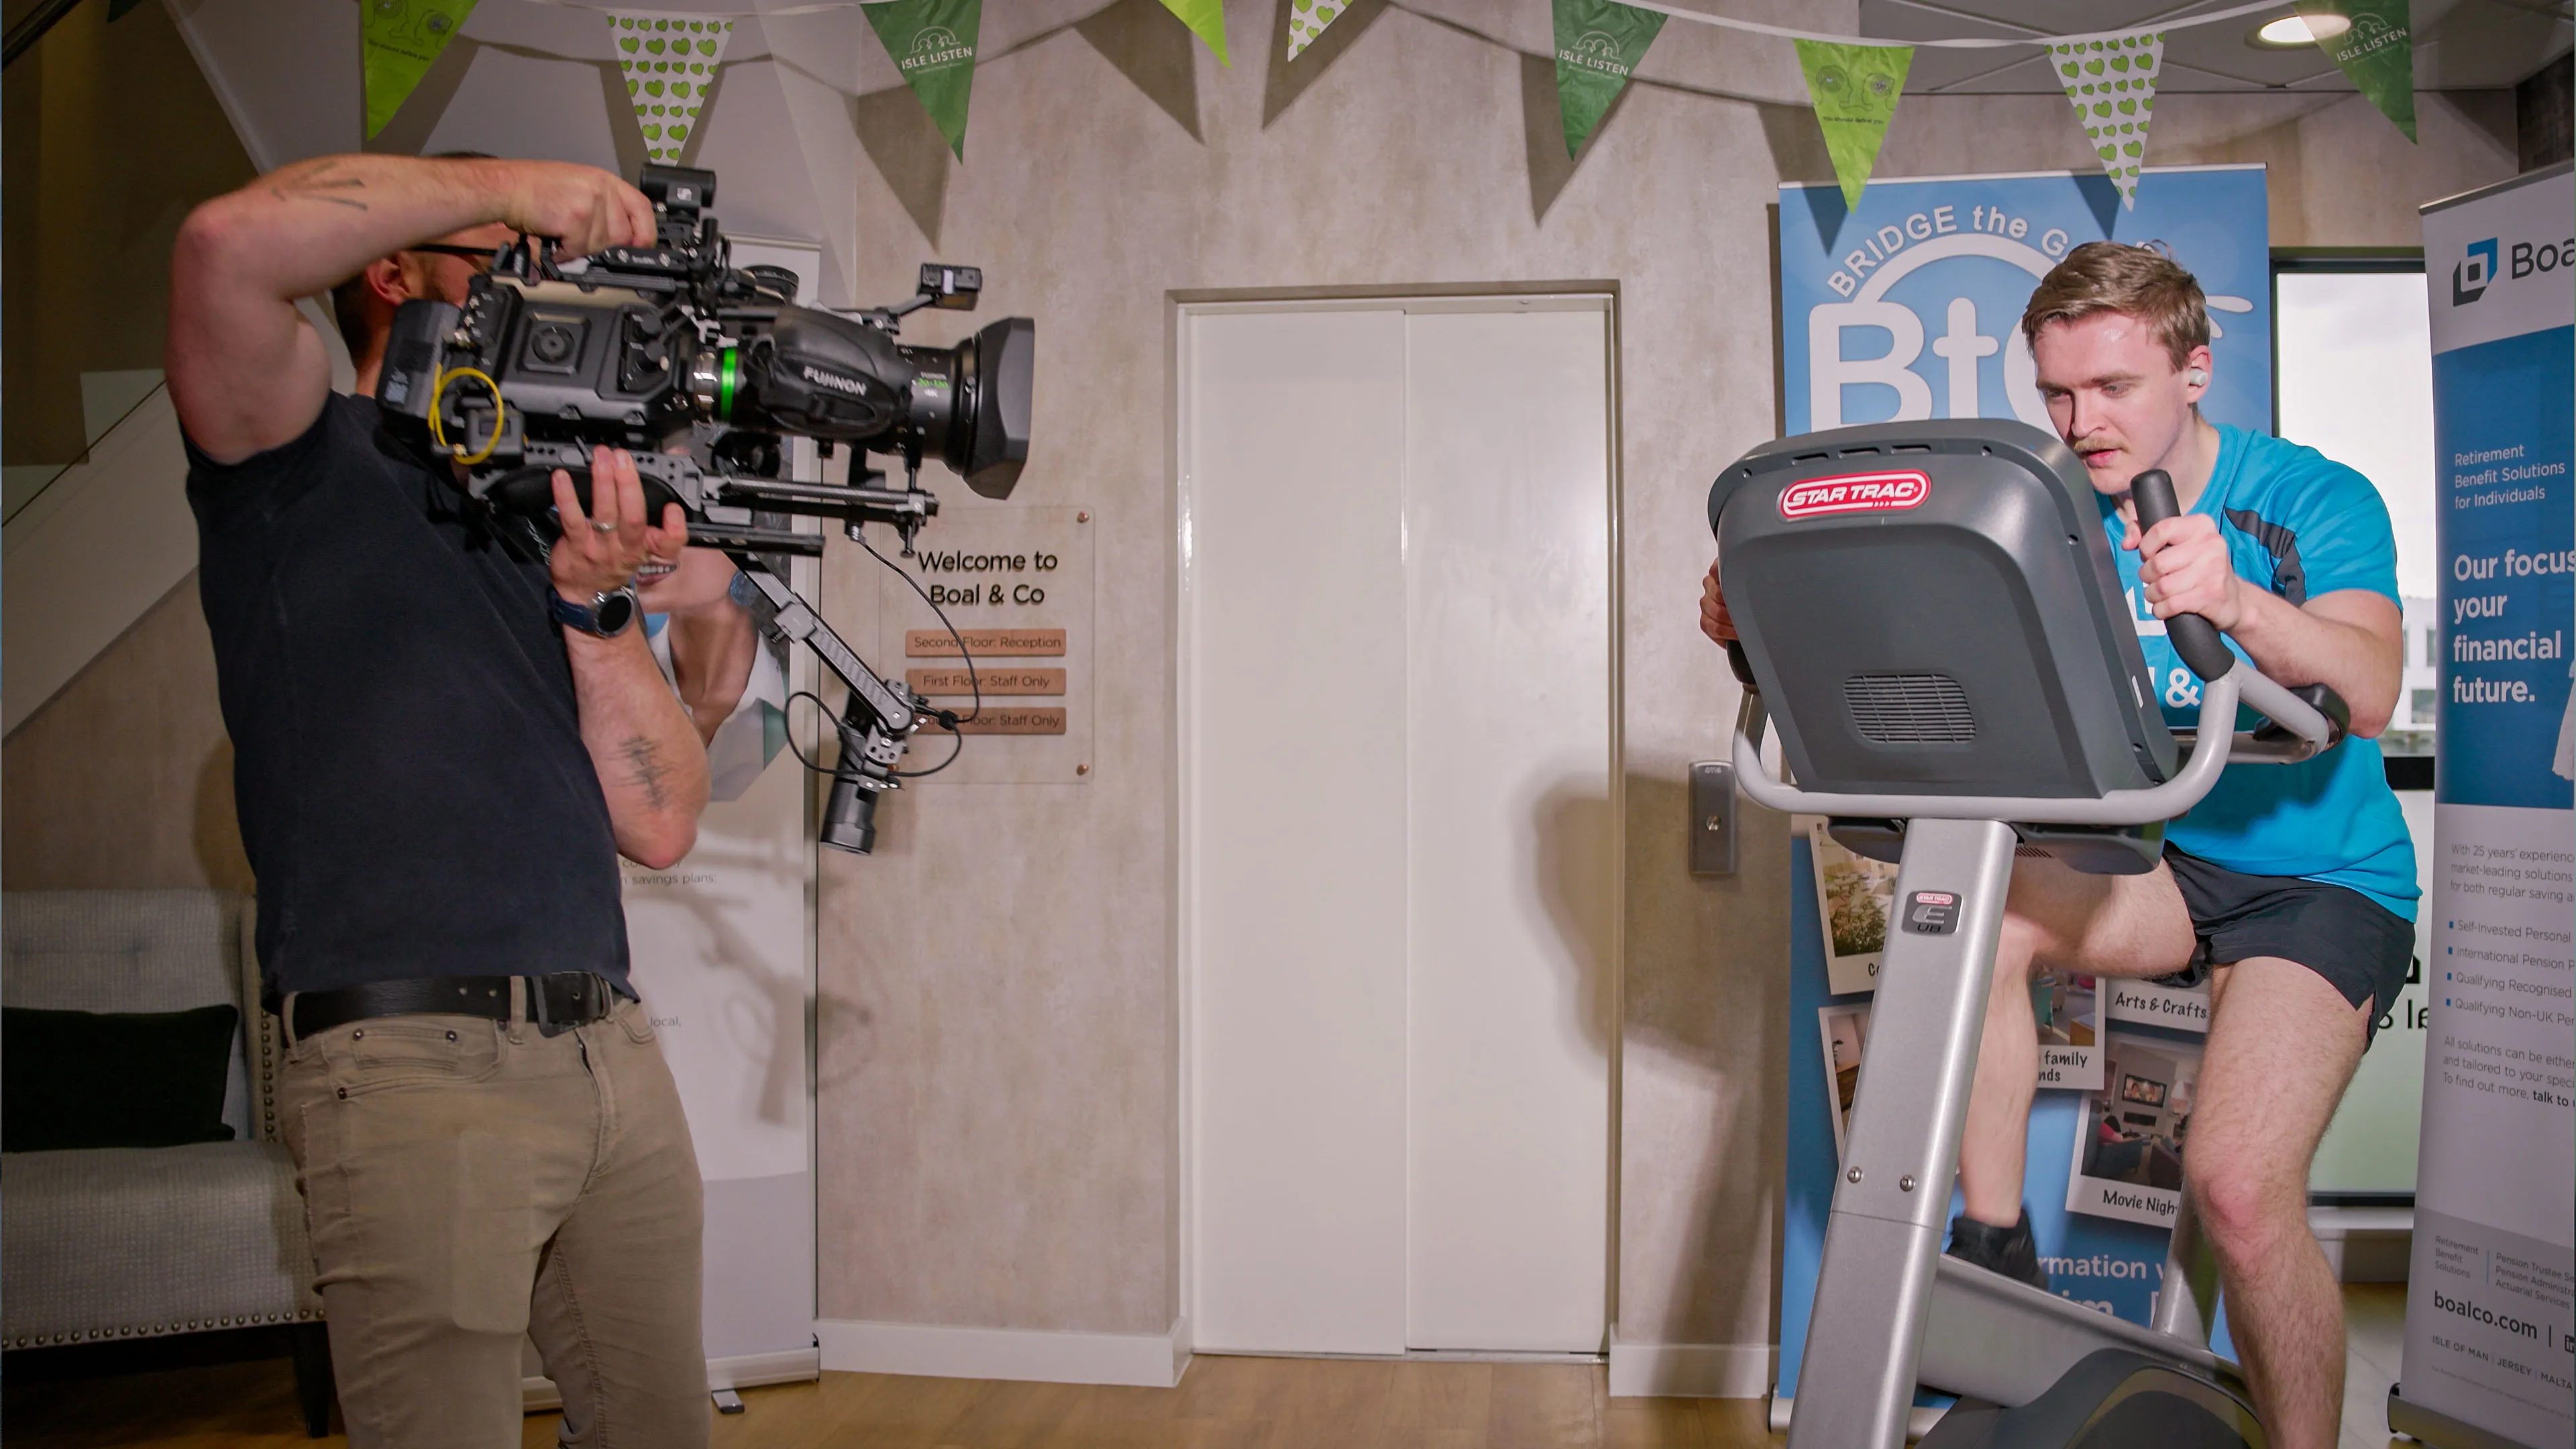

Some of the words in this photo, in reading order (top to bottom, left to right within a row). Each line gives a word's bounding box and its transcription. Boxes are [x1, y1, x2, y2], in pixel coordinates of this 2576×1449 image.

[2337, 46, 2362, 62] ISLE
[2363, 28, 2407, 52] LISTEN
[901, 55, 926, 70] ISLE
[930, 46, 973, 64] LISTEN
[1559, 49, 1584, 64] ISLE
[1587, 57, 1629, 76] LISTEN
[1827, 205, 1957, 297] BRIDGE
[1972, 205, 2028, 239] the
[803, 366, 867, 396] FUJINON
[2455, 444, 2524, 467] Retirement
[2455, 470, 2498, 488] Benefit
[2502, 462, 2565, 482] Solutions
[1788, 487, 1847, 507] STAR
[1849, 482, 1915, 500] TRAC
[2455, 496, 2471, 509] for
[2474, 485, 2546, 507] Individuals
[918, 549, 1026, 573] Welcome
[1034, 550, 1058, 573] to
[2455, 554, 2498, 582] Our
[930, 583, 980, 606] Boal
[988, 584, 1005, 606] &
[1013, 584, 1045, 605] Co
[2453, 595, 2508, 625] your
[914, 636, 958, 648] Second
[963, 636, 996, 648] Floor:
[1000, 636, 1061, 649] Reception
[2453, 630, 2561, 662] financial
[923, 675, 949, 687] First
[990, 675, 1019, 687] Staff
[1022, 675, 1051, 690] Only
[2165, 667, 2201, 708] &
[2453, 676, 2535, 703] future.
[999, 714, 1028, 726] Staff
[1031, 714, 1059, 729] Only
[2451, 843, 2471, 855] With
[2473, 845, 2485, 857] 25
[632, 874, 678, 885] savings
[2451, 863, 2521, 880] market-leading
[2525, 868, 2573, 883] solutions
[2451, 879, 2461, 892] for
[2463, 881, 2485, 894] both
[2488, 885, 2526, 898] regular
[2529, 888, 2563, 903] saving
[2457, 919, 2522, 938] Self-Invested
[2526, 926, 2571, 943] Personal
[2457, 946, 2518, 965] International
[2523, 953, 2565, 970] Pension
[2457, 971, 2506, 991] Qualifying
[2509, 979, 2572, 998] Recognised
[2115, 991, 2146, 1010] Arts
[2149, 998, 2159, 1012] &
[2163, 999, 2207, 1018] Crafts
[2455, 998, 2506, 1018] Qualifying
[2509, 1006, 2553, 1023] Non-UK
[2044, 1050, 2088, 1069] family
[2445, 1036, 2455, 1047] All
[2458, 1039, 2502, 1057] solutions
[2506, 1049, 2525, 1060] can
[2528, 1049, 2542, 1063] be
[2443, 1055, 2459, 1067] and
[2462, 1059, 2501, 1075] tailored
[2505, 1066, 2516, 1077] to
[2519, 1071, 2544, 1082] your
[2443, 1071, 2453, 1083] To
[2455, 1074, 2474, 1088] find
[2477, 1081, 2496, 1093] out
[2532, 1089, 2553, 1104] talk
[2557, 1095, 2569, 1107] to
[2103, 1189, 2142, 1209] Movie
[2146, 1197, 2178, 1216] Nigh
[2435, 1235, 2479, 1256] Retirement
[2435, 1248, 2463, 1264] Benefit
[2435, 1261, 2471, 1279] Solutions
[2496, 1252, 2528, 1270] Pension
[2531, 1262, 2562, 1280] Trustee
[2496, 1265, 2528, 1283] Pension
[2496, 1279, 2532, 1298] Actuarial
[2535, 1290, 2571, 1309] Services
[2434, 1289, 2537, 1340] boalco.com
[2431, 1334, 2451, 1348] ISLE
[2453, 1342, 2466, 1353] OF
[2468, 1348, 2489, 1362] MAN
[2497, 1357, 2532, 1376] JERSEY
[2540, 1372, 2573, 1391] MALTA
